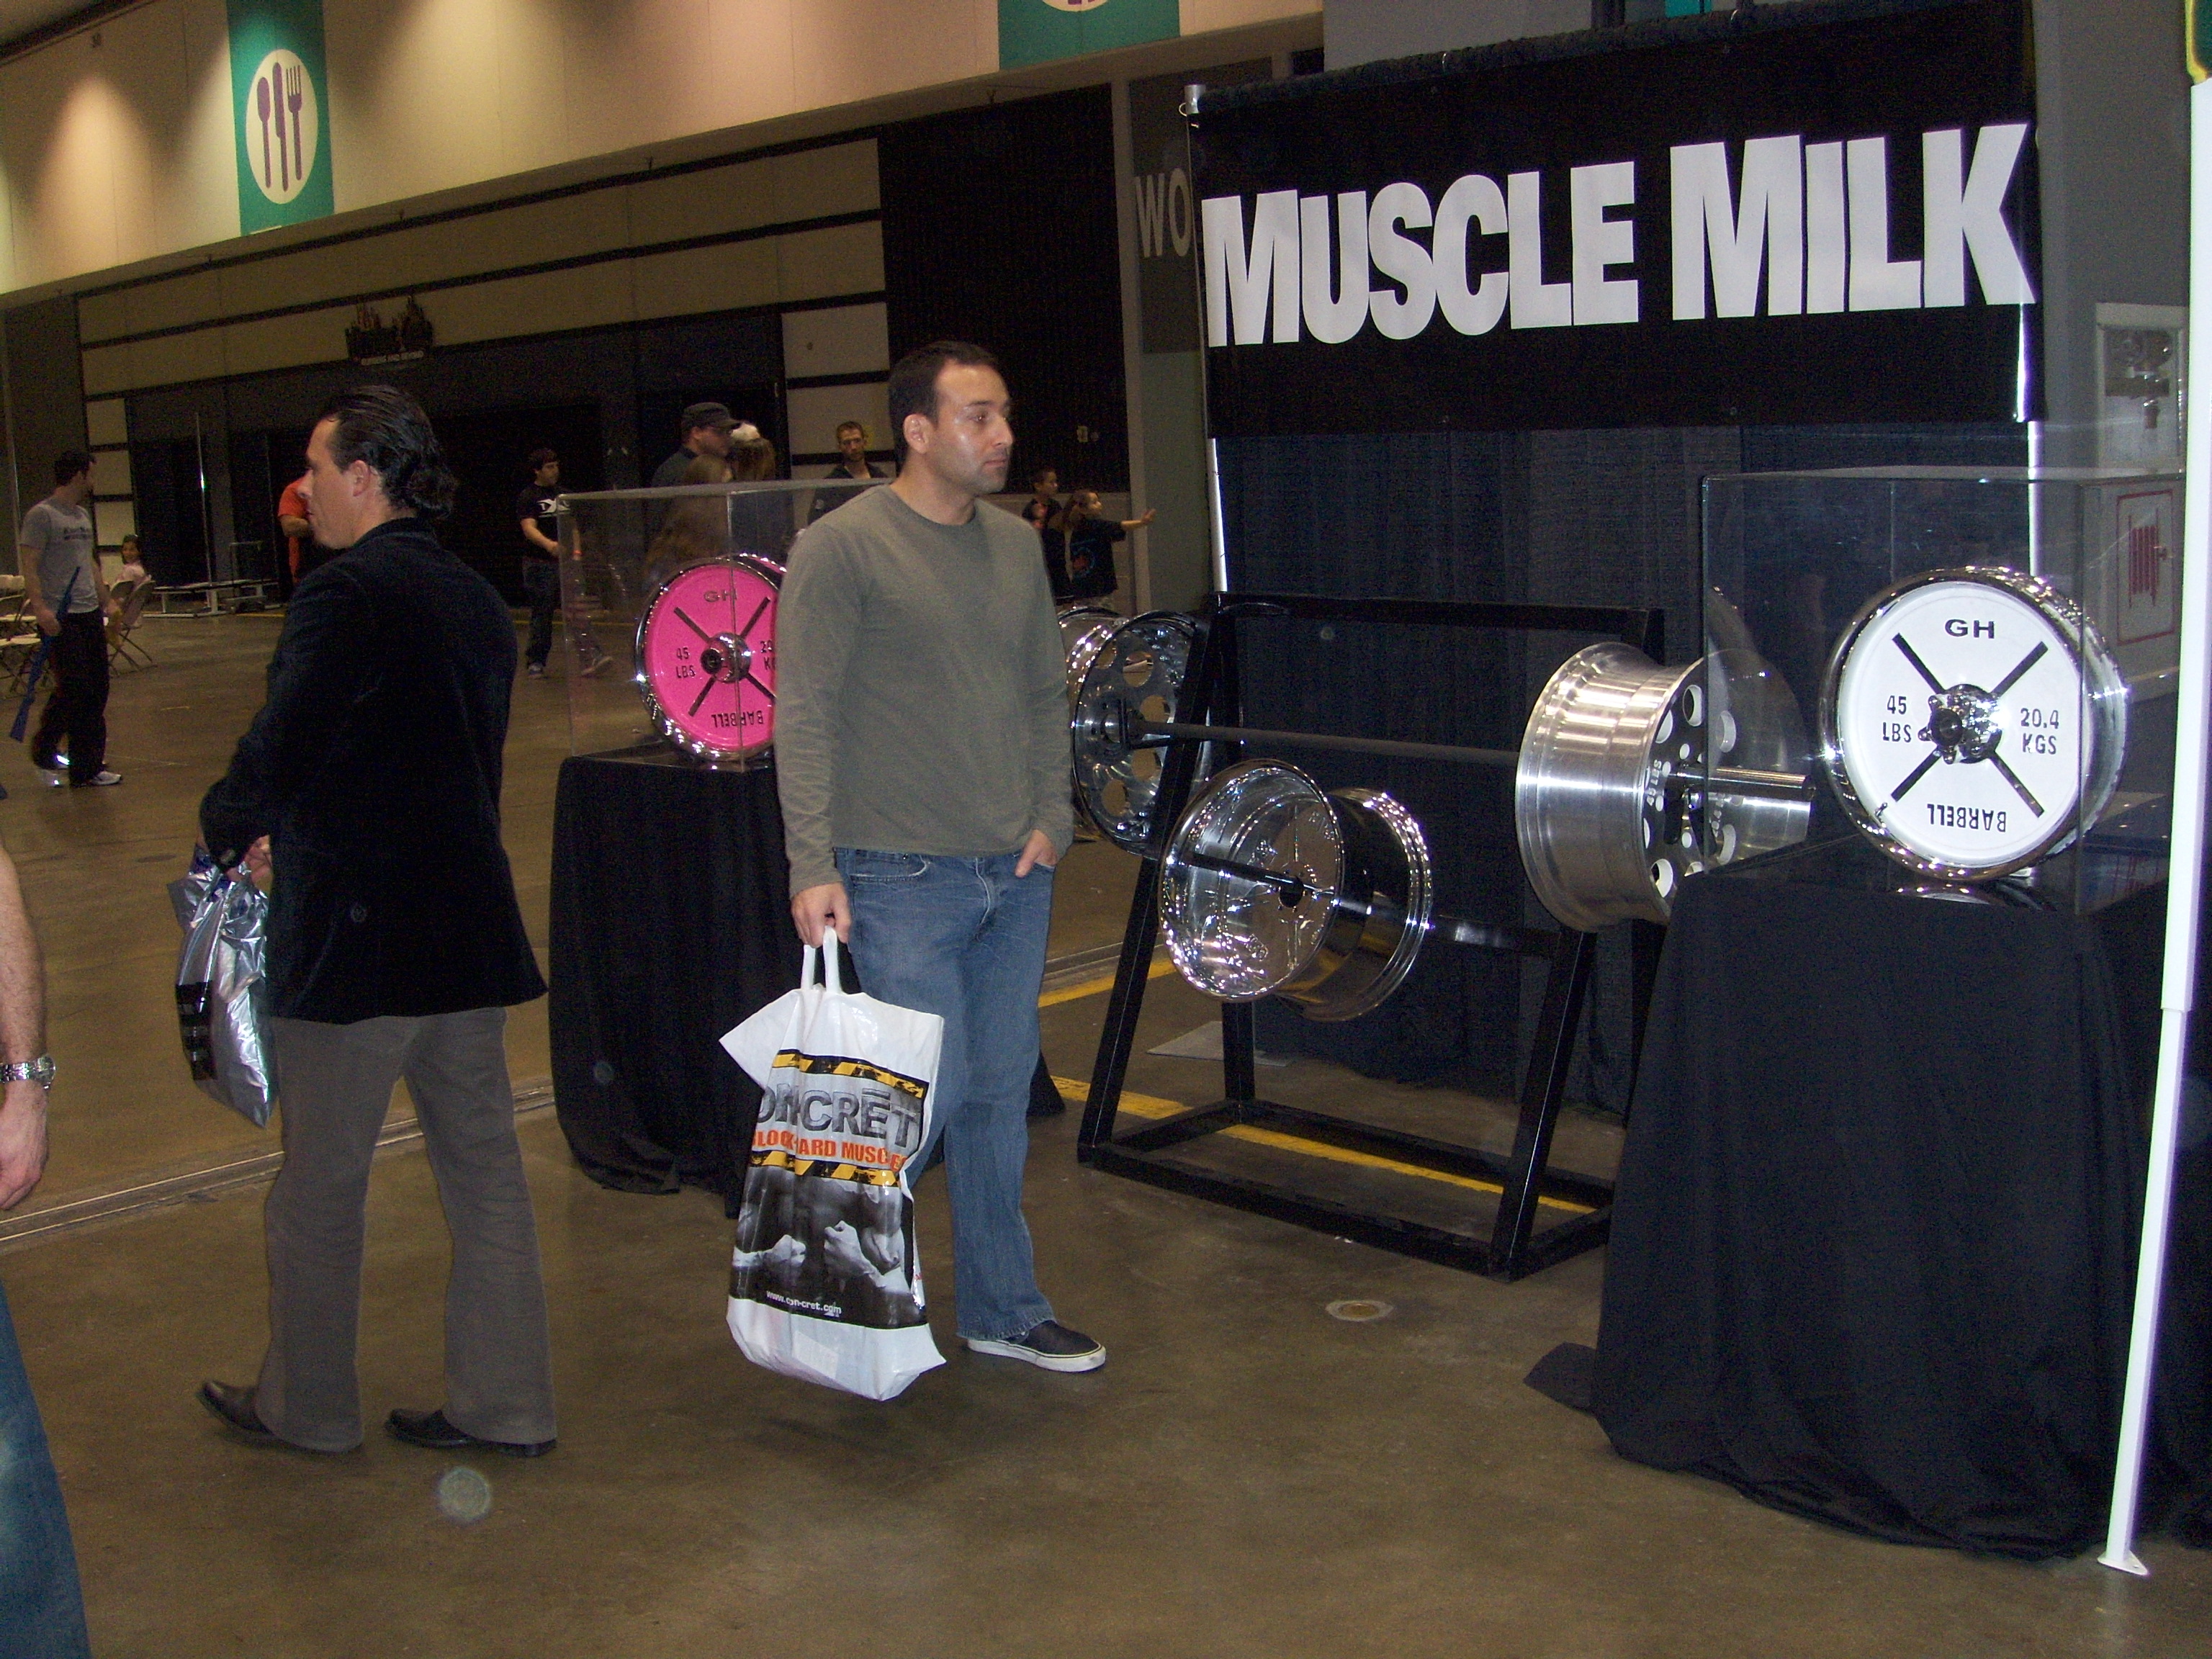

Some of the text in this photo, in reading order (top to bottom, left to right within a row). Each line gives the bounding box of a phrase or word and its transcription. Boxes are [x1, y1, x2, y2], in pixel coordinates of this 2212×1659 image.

[1134, 167, 1192, 257] WO
[1201, 123, 2036, 348] MUSCLE MILK
[704, 590, 737, 602] GH
[1944, 619, 1995, 639] GH
[675, 647, 691, 660] 45
[675, 665, 696, 679] LBS
[1886, 695, 1907, 716] 45
[711, 709, 765, 729] BARBELL
[2020, 707, 2059, 729] 20.4
[1882, 721, 1912, 743] LBS
[2021, 734, 2057, 755] KGS
[1926, 803, 2008, 833] BARBELL
